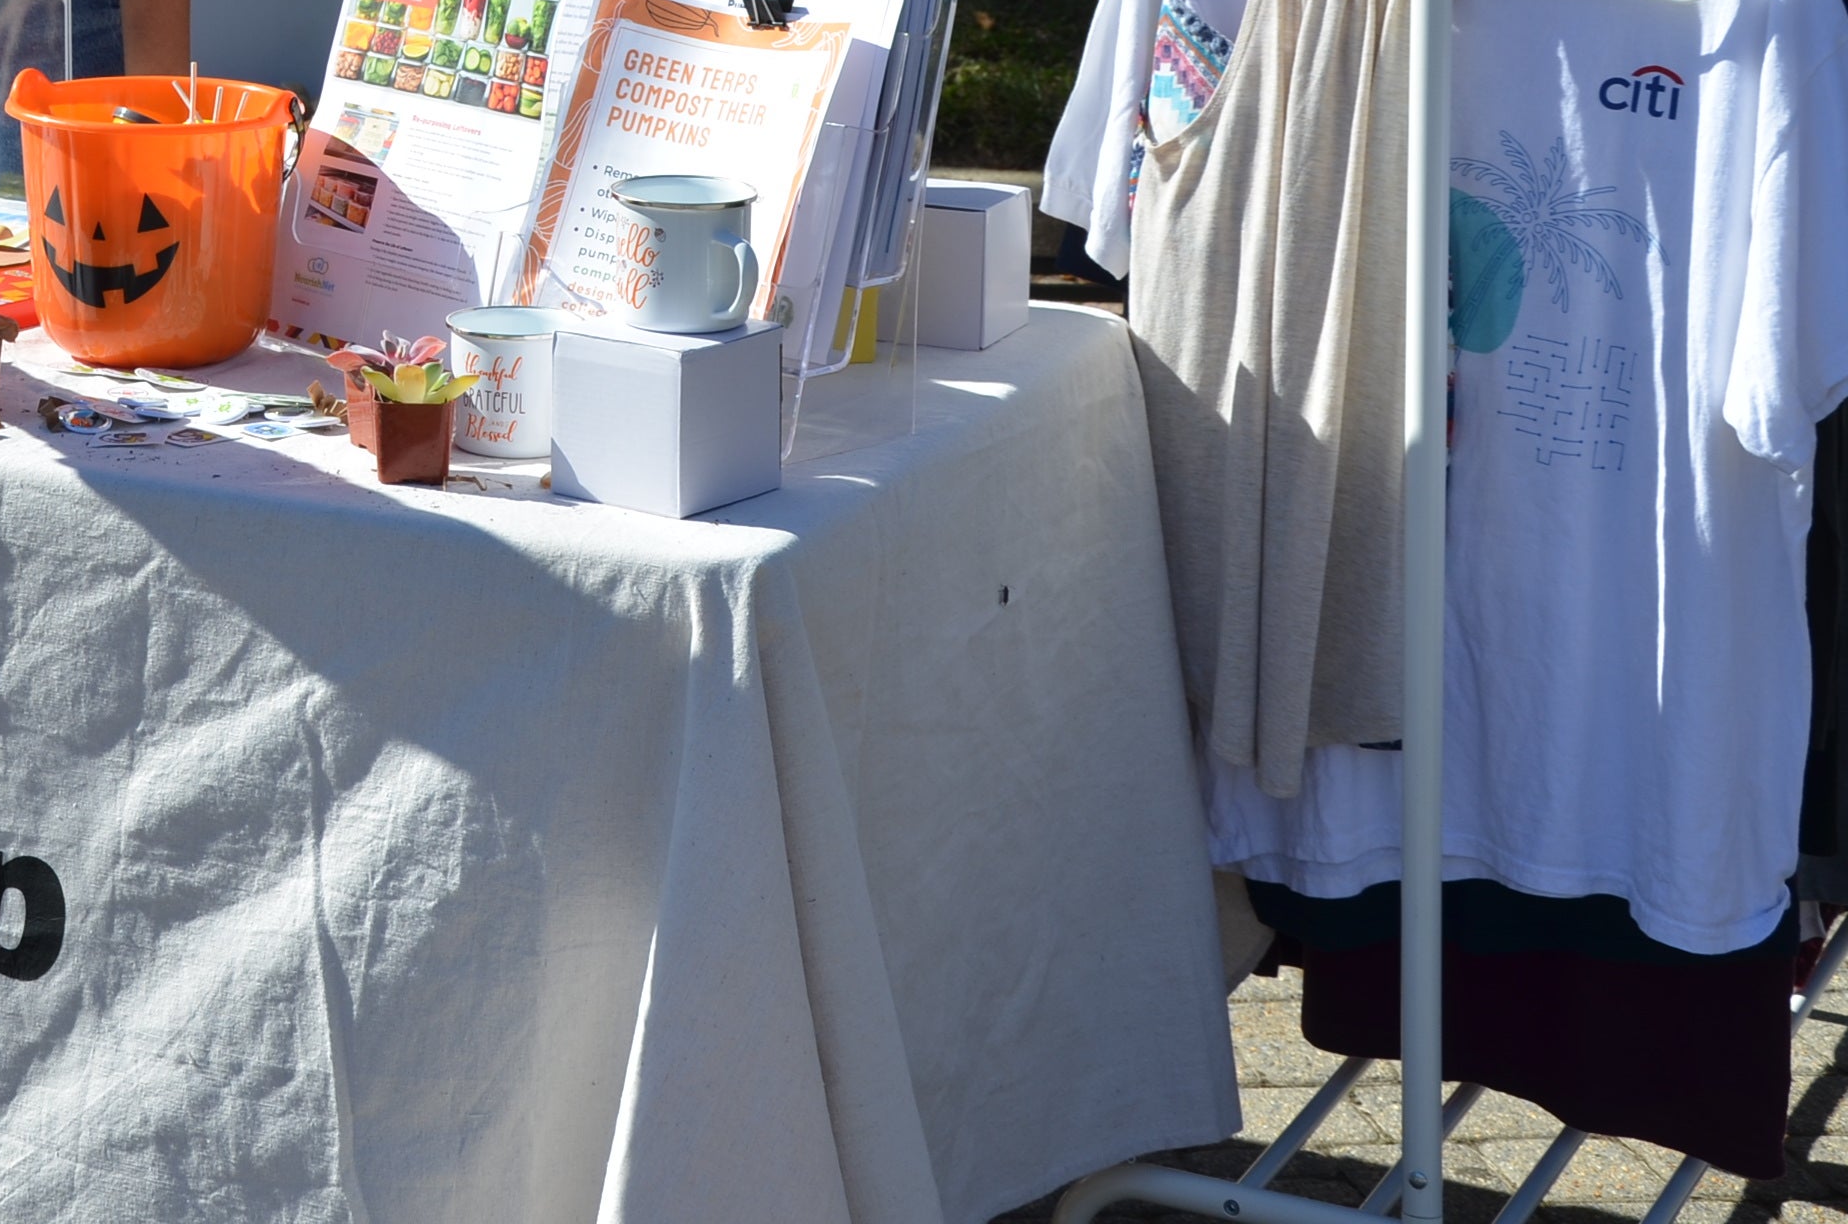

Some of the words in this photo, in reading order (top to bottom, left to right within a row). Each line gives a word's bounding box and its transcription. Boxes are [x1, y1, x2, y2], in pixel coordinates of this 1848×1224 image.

[624, 48, 695, 85] GREEN
[702, 67, 758, 95] TERPS
[1599, 71, 1682, 120] citi
[615, 77, 714, 118] COMPOST
[716, 100, 767, 126] THEIR
[606, 107, 711, 148] PUMPKINS
